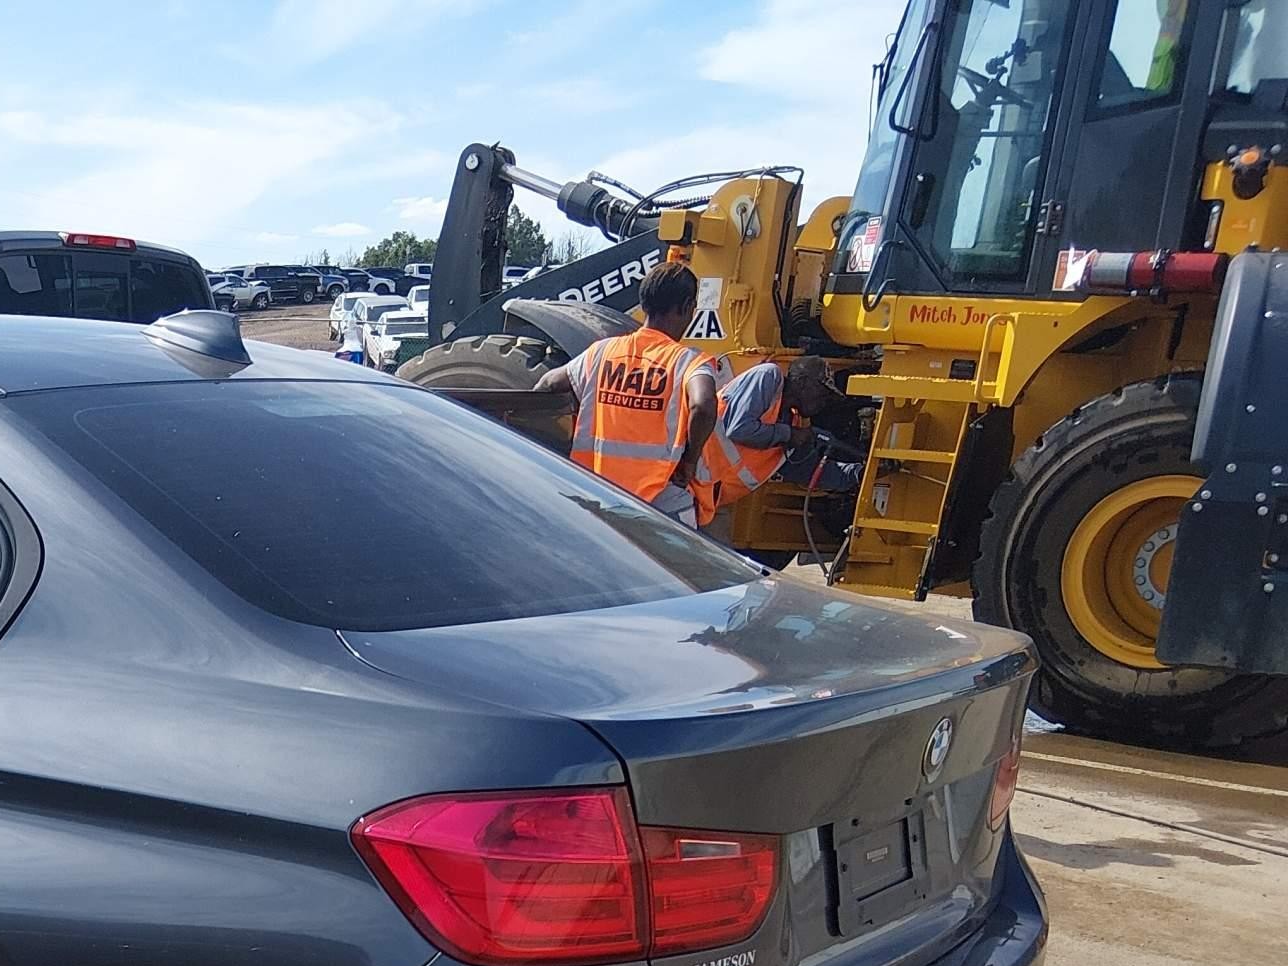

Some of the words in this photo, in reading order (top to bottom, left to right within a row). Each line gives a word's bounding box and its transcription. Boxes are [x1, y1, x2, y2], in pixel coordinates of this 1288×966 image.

[557, 249, 661, 304] DEERE
[910, 304, 956, 323] Mitch
[599, 360, 668, 396] MAD
[600, 392, 658, 409] SERVICES
